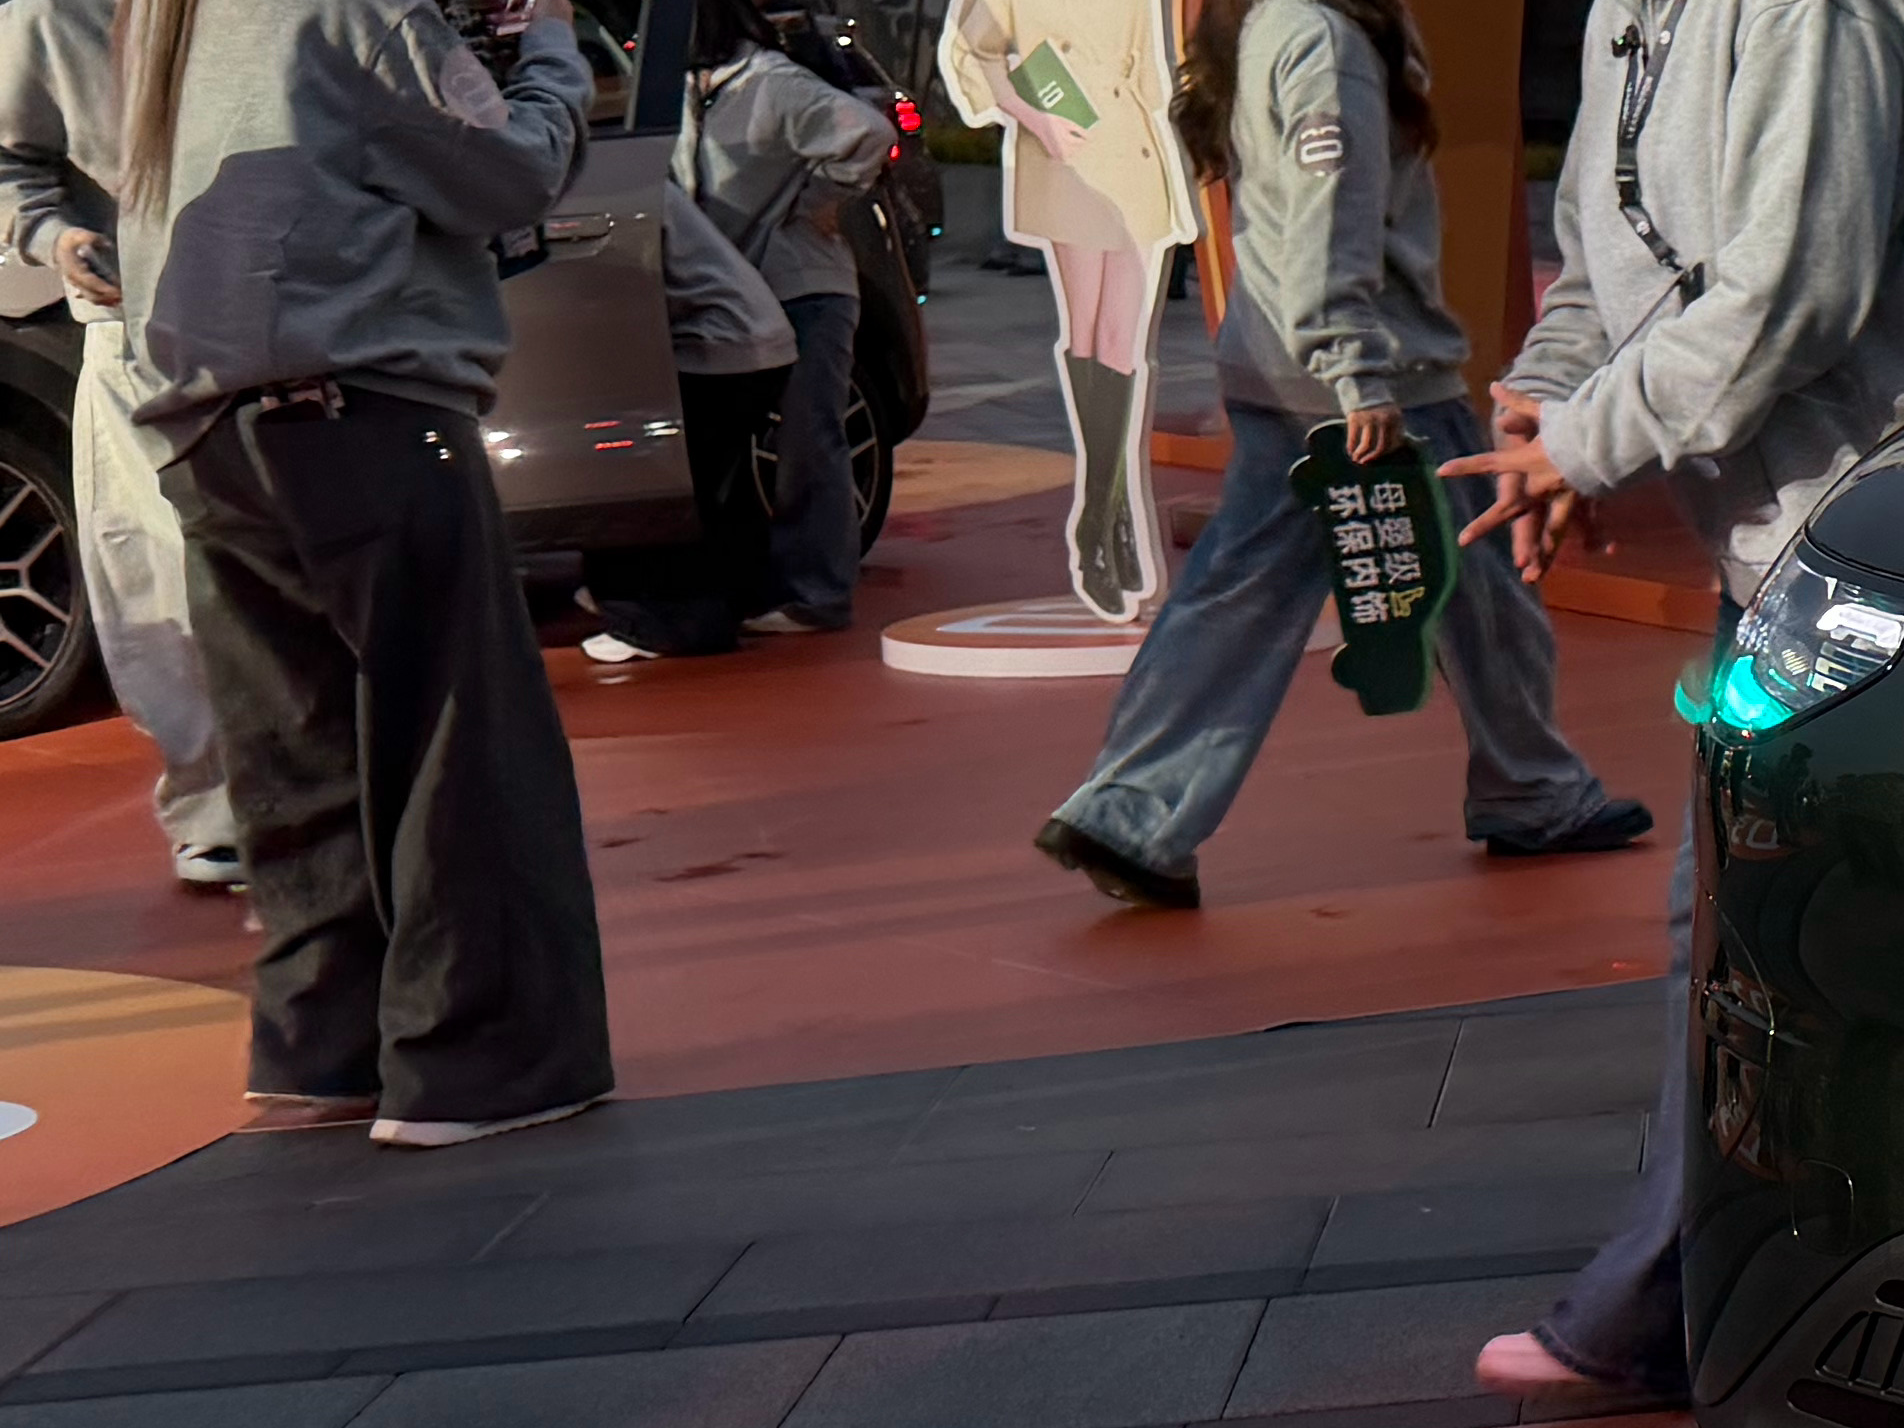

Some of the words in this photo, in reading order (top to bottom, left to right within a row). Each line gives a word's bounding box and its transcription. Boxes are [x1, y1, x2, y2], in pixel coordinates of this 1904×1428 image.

[1327, 483, 1390, 624] 环保内饰
[1369, 480, 1422, 585] 母婴级
